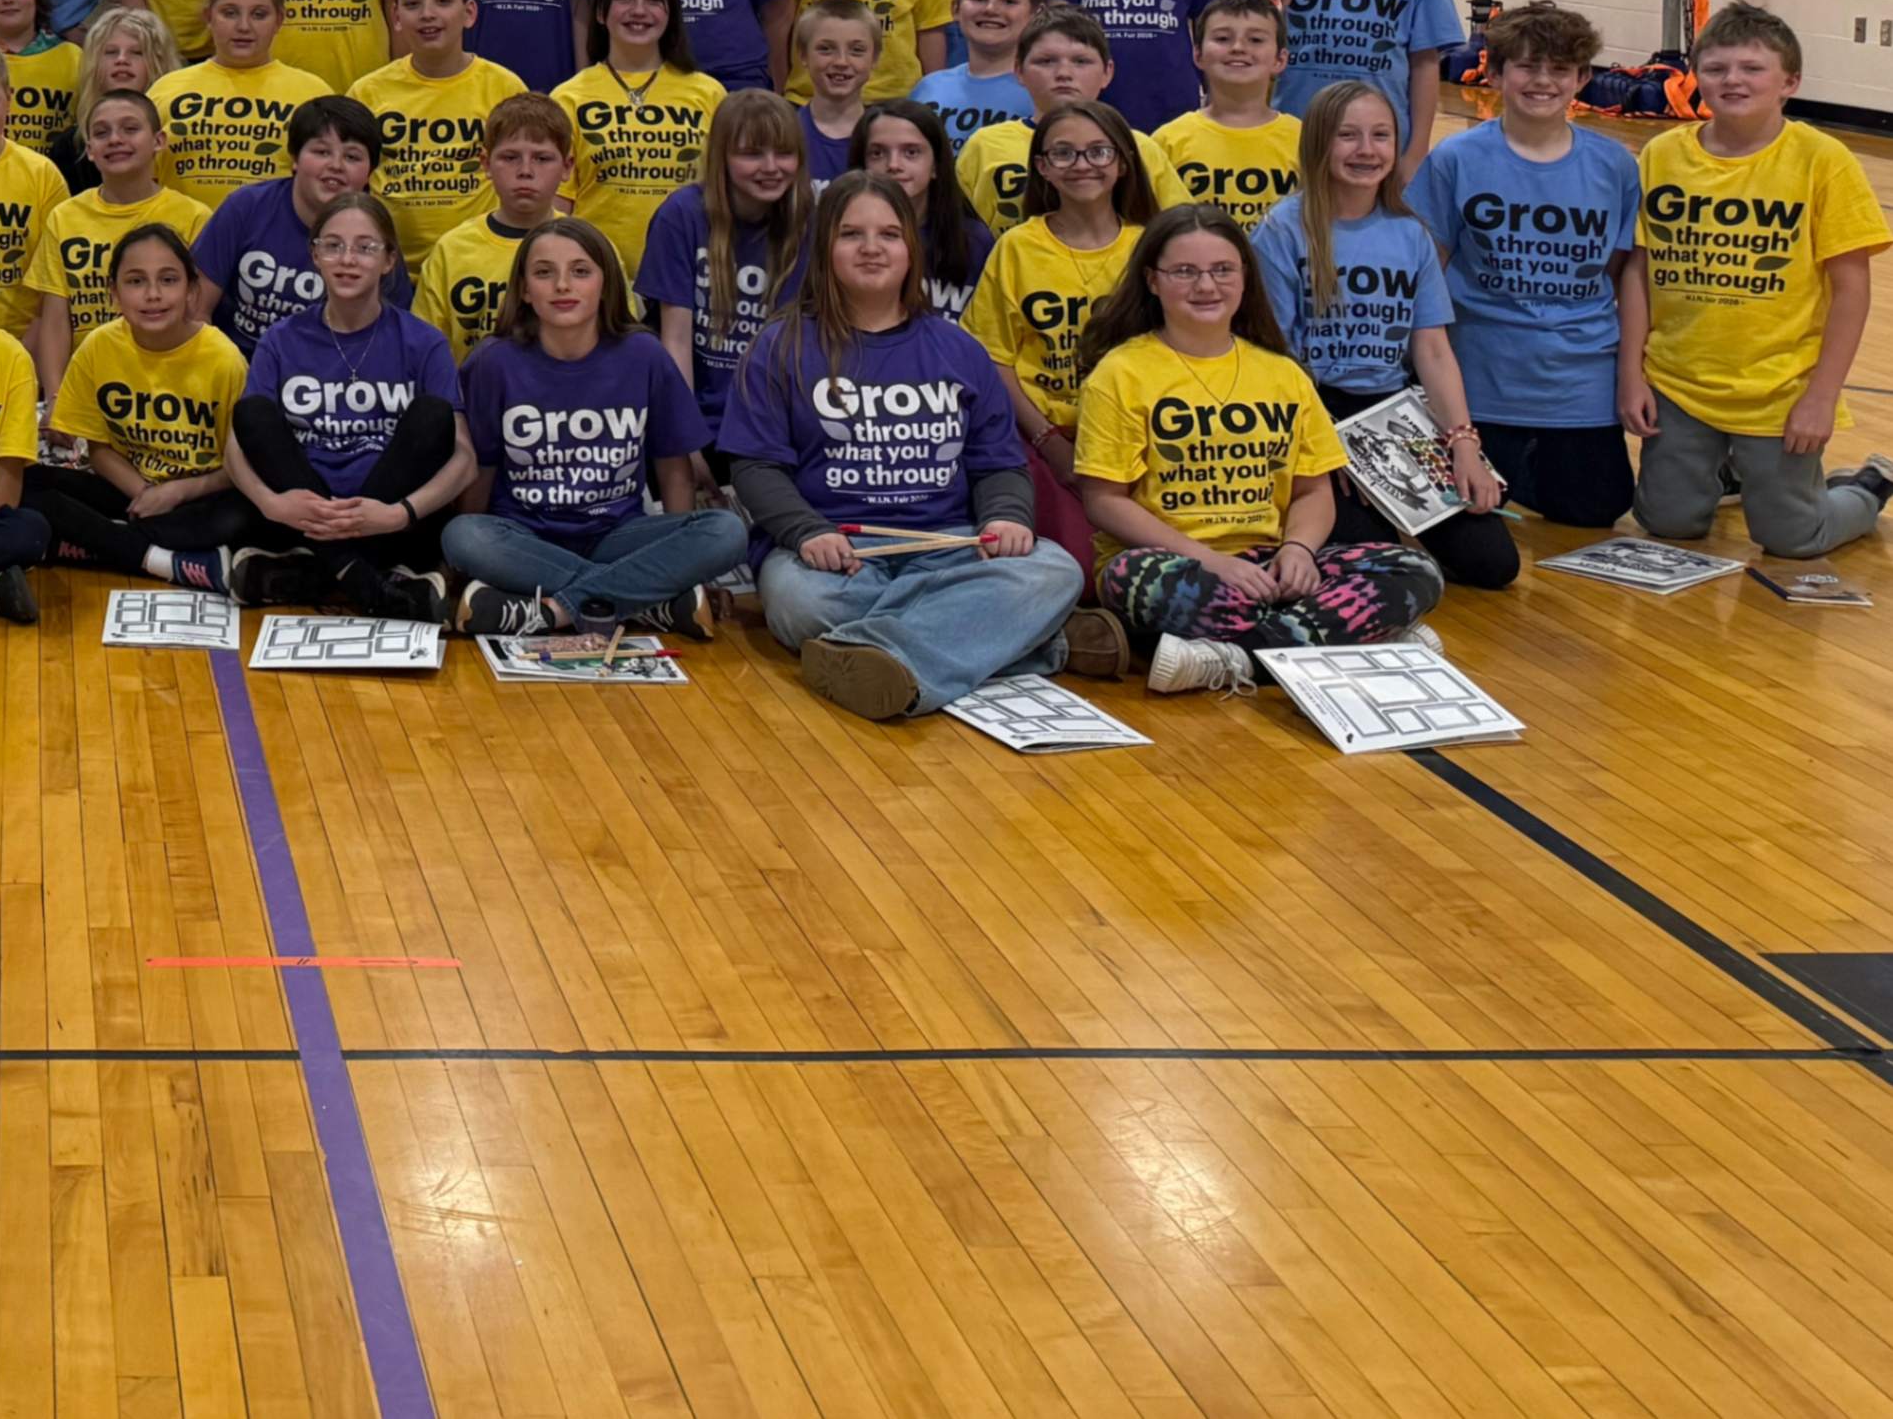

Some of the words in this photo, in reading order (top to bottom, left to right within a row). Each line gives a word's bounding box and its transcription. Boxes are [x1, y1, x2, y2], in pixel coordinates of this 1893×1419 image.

[299, 5, 371, 22] through
[1109, 10, 1179, 28] through
[1309, 15, 1395, 38] through
[1287, 32, 1328, 46] what
[1332, 33, 1368, 48] you
[1288, 50, 1308, 65] go
[1314, 48, 1392, 71] through
[170, 93, 294, 124] Grow
[578, 100, 704, 129] Grow
[191, 123, 281, 140] through
[379, 111, 485, 145] Grow
[608, 128, 700, 146] through
[170, 138, 211, 154] what
[216, 139, 249, 154] you
[400, 145, 482, 163] through
[590, 145, 633, 165] what
[636, 146, 671, 162] you
[176, 159, 195, 175] go
[198, 156, 276, 176] through
[421, 160, 454, 174] you
[597, 164, 618, 181] go
[620, 163, 697, 183] through
[383, 180, 402, 195] go
[405, 176, 479, 193] through
[1179, 162, 1302, 196] Grow
[1463, 193, 1608, 237] Grow
[1646, 184, 1804, 229] Grow
[1496, 235, 1603, 260] through
[1676, 225, 1789, 252] through
[1650, 247, 1699, 265] what
[1705, 250, 1746, 269] you
[1529, 260, 1569, 279] you
[1655, 267, 1680, 285] go
[1684, 267, 1785, 293] through
[1479, 272, 1504, 290] go
[1508, 275, 1600, 300] through
[1346, 323, 1380, 341] you
[1328, 341, 1406, 363] through
[97, 382, 219, 428] Grow
[282, 375, 414, 415] Grow
[813, 376, 964, 420] Grow
[313, 415, 398, 436] throug
[502, 405, 648, 448] Grow
[1152, 397, 1299, 441] Grow
[126, 423, 214, 450] through
[854, 418, 961, 443] through
[536, 442, 639, 469] through
[825, 444, 881, 460] what
[887, 445, 929, 466] you
[1187, 438, 1290, 463] through
[509, 468, 564, 482] what
[570, 467, 609, 486] you
[826, 469, 860, 488] go
[1159, 463, 1216, 483] what
[1223, 464, 1267, 483] you
[513, 486, 542, 504] go
[546, 480, 637, 505] through
[1161, 491, 1196, 510] go
